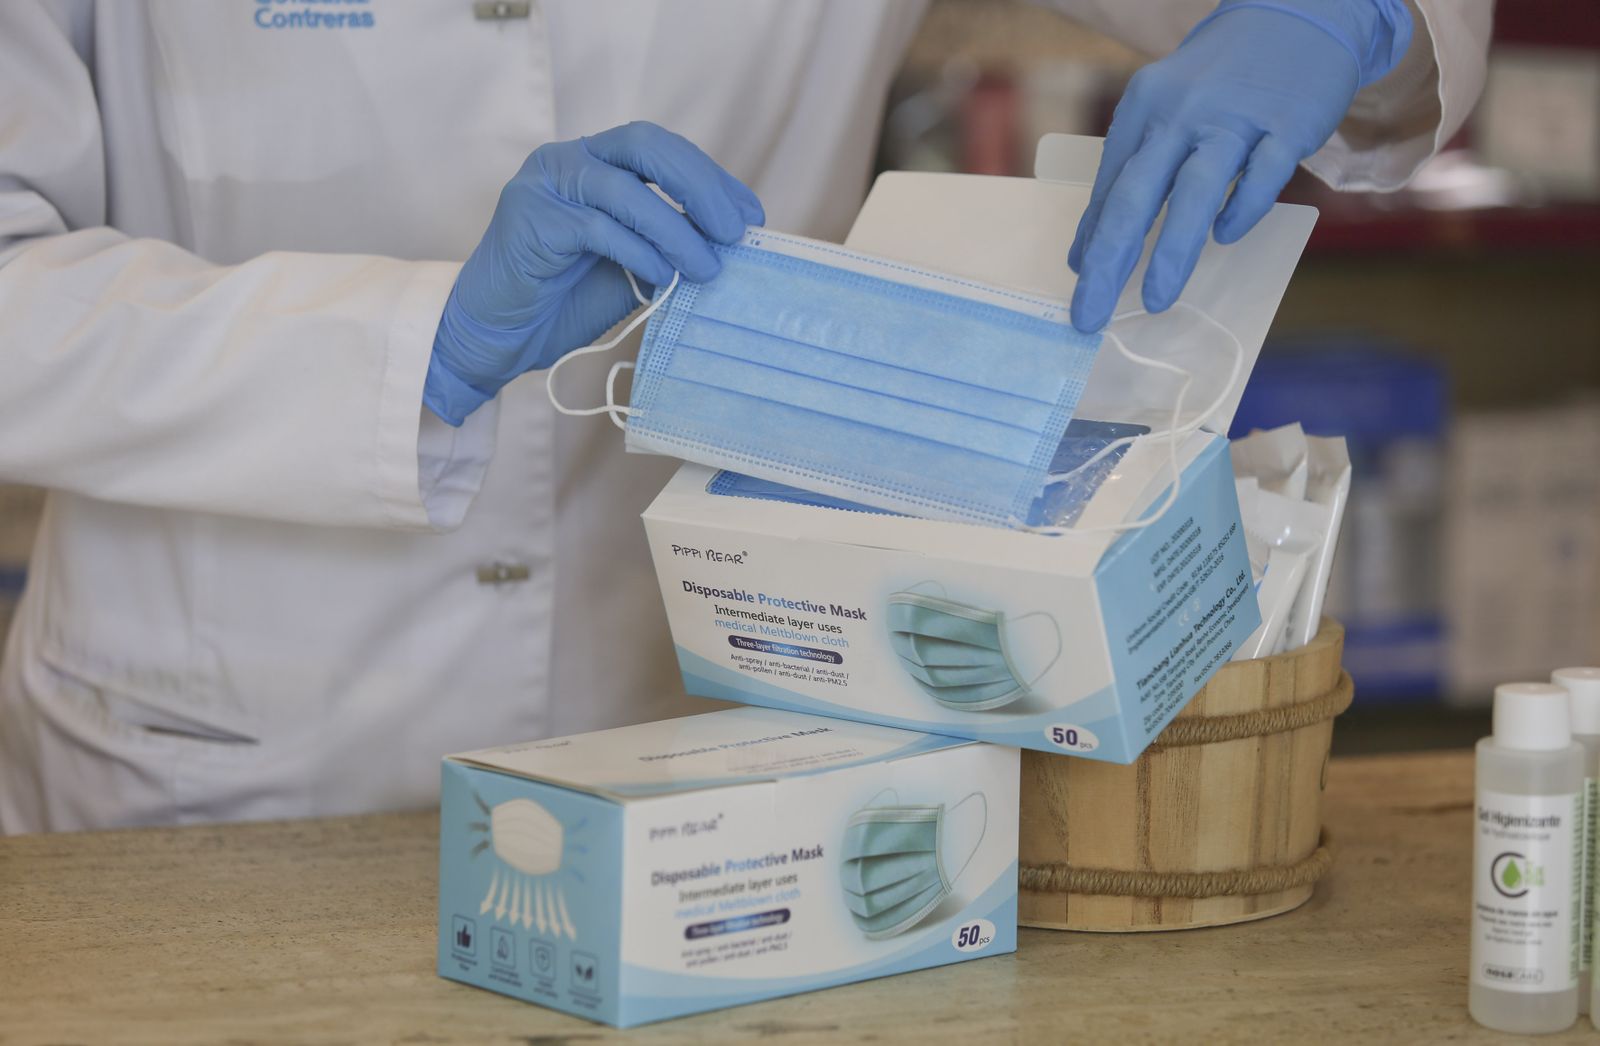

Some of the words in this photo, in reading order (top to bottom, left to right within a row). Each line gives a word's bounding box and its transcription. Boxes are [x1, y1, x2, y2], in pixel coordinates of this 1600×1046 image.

[255, 8, 375, 28] Contreras
[682, 580, 755, 603] Disposable
[757, 592, 827, 615] Protective
[830, 603, 868, 621] Mask
[1227, 584, 1249, 612] Development
[714, 605, 785, 625] Intermediate
[787, 616, 814, 631] layer
[818, 621, 843, 634] uses
[715, 618, 757, 633] medical
[760, 626, 822, 643] Meltblown
[823, 635, 850, 648] cloth
[1224, 614, 1235, 628] China
[799, 648, 836, 663] technology
[1137, 654, 1168, 690] Tianchang
[1170, 630, 1192, 657] Lianhua
[1194, 596, 1225, 632] Technology
[1052, 727, 1078, 746] 50
[651, 863, 722, 886] Disposable
[724, 853, 788, 873] Protective
[791, 844, 824, 863] Mask
[679, 882, 746, 903] Intermediate
[748, 878, 775, 892] layer
[775, 874, 799, 886] uses
[957, 924, 981, 948] 50
[979, 936, 991, 946] pcs
